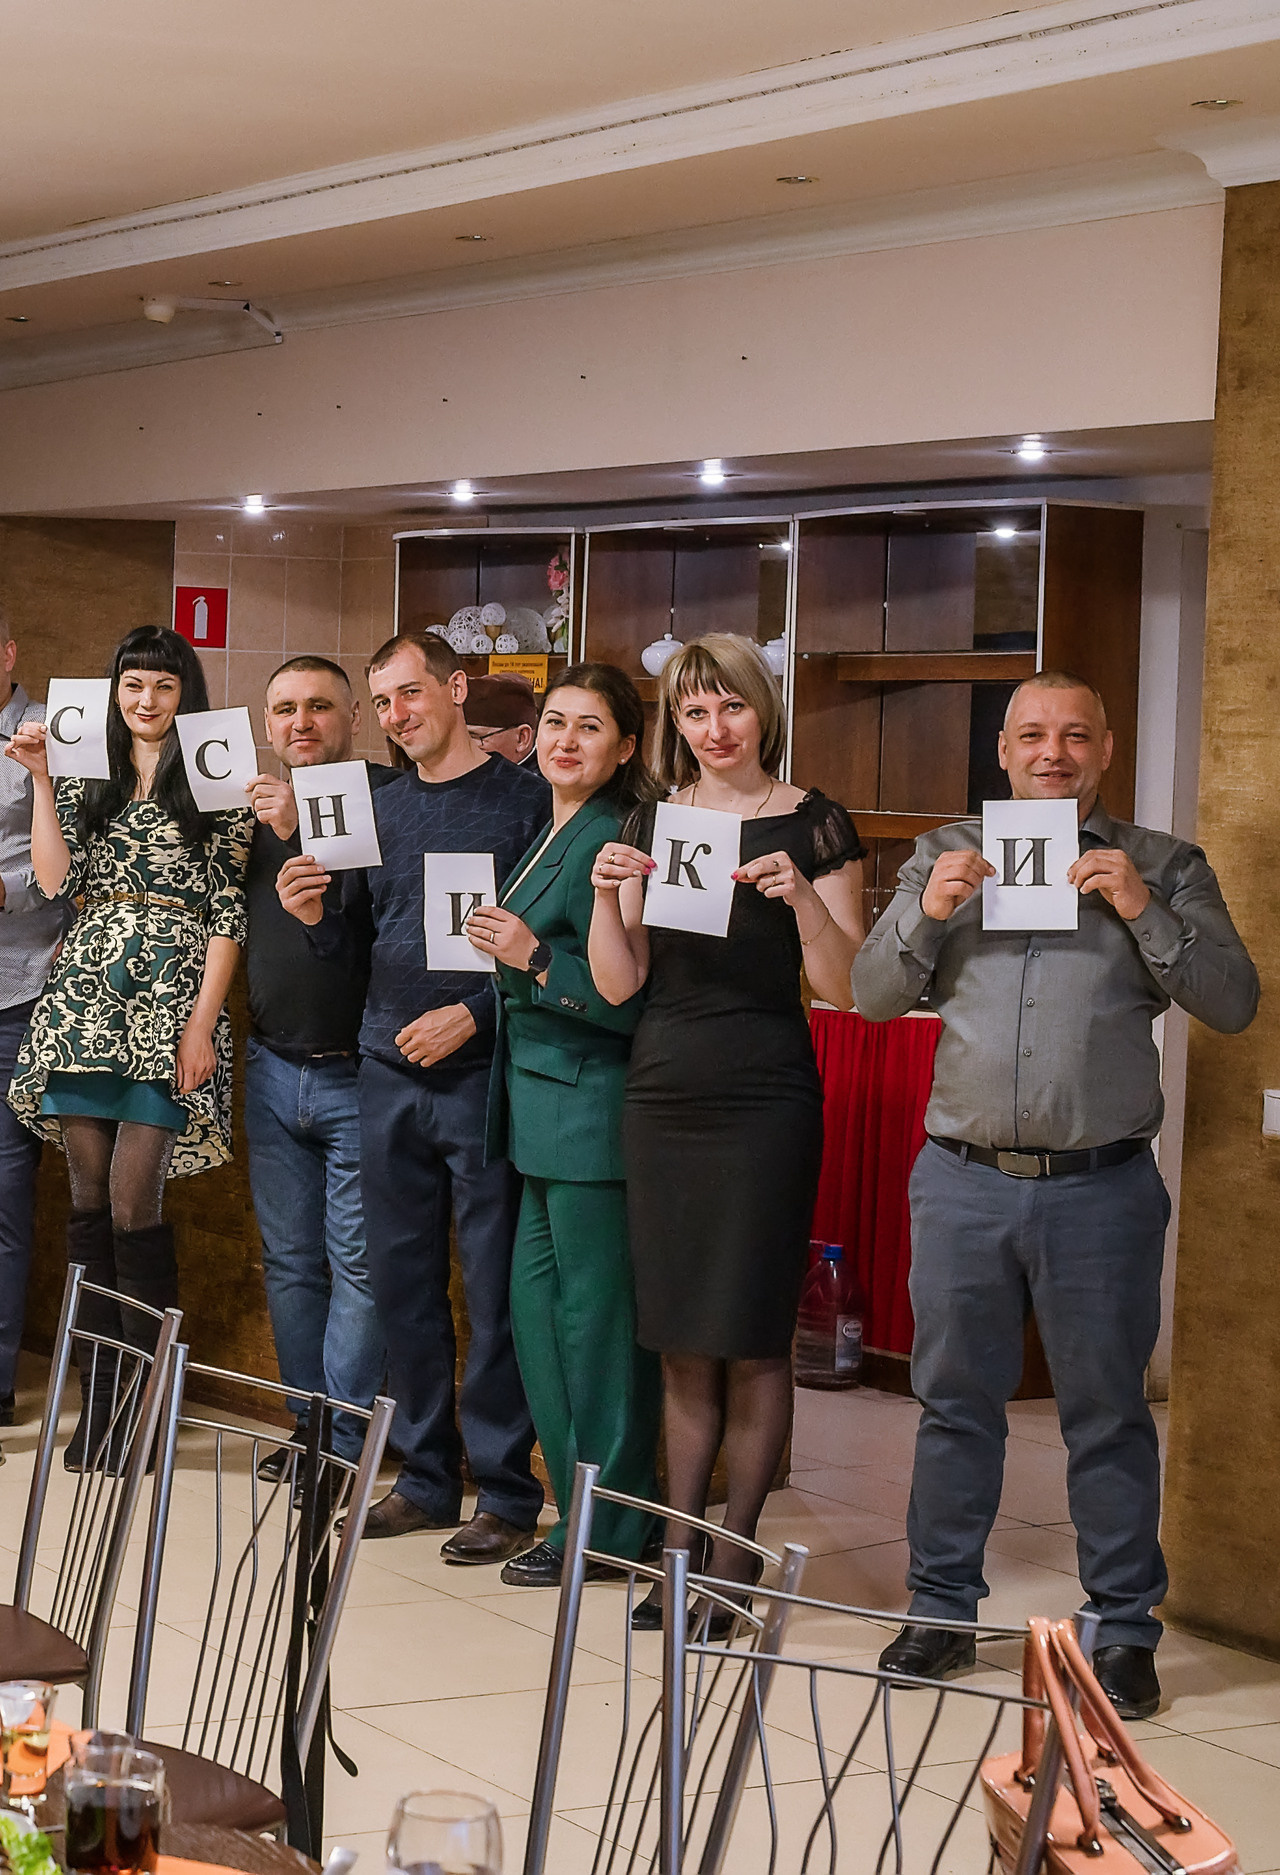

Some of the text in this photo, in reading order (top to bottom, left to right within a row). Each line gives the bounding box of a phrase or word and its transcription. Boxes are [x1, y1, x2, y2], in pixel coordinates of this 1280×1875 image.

[50, 705, 86, 745] С
[195, 738, 232, 780] С
[302, 793, 352, 840] Н
[661, 837, 712, 890] К
[996, 837, 1053, 887] И
[445, 892, 486, 936] И
